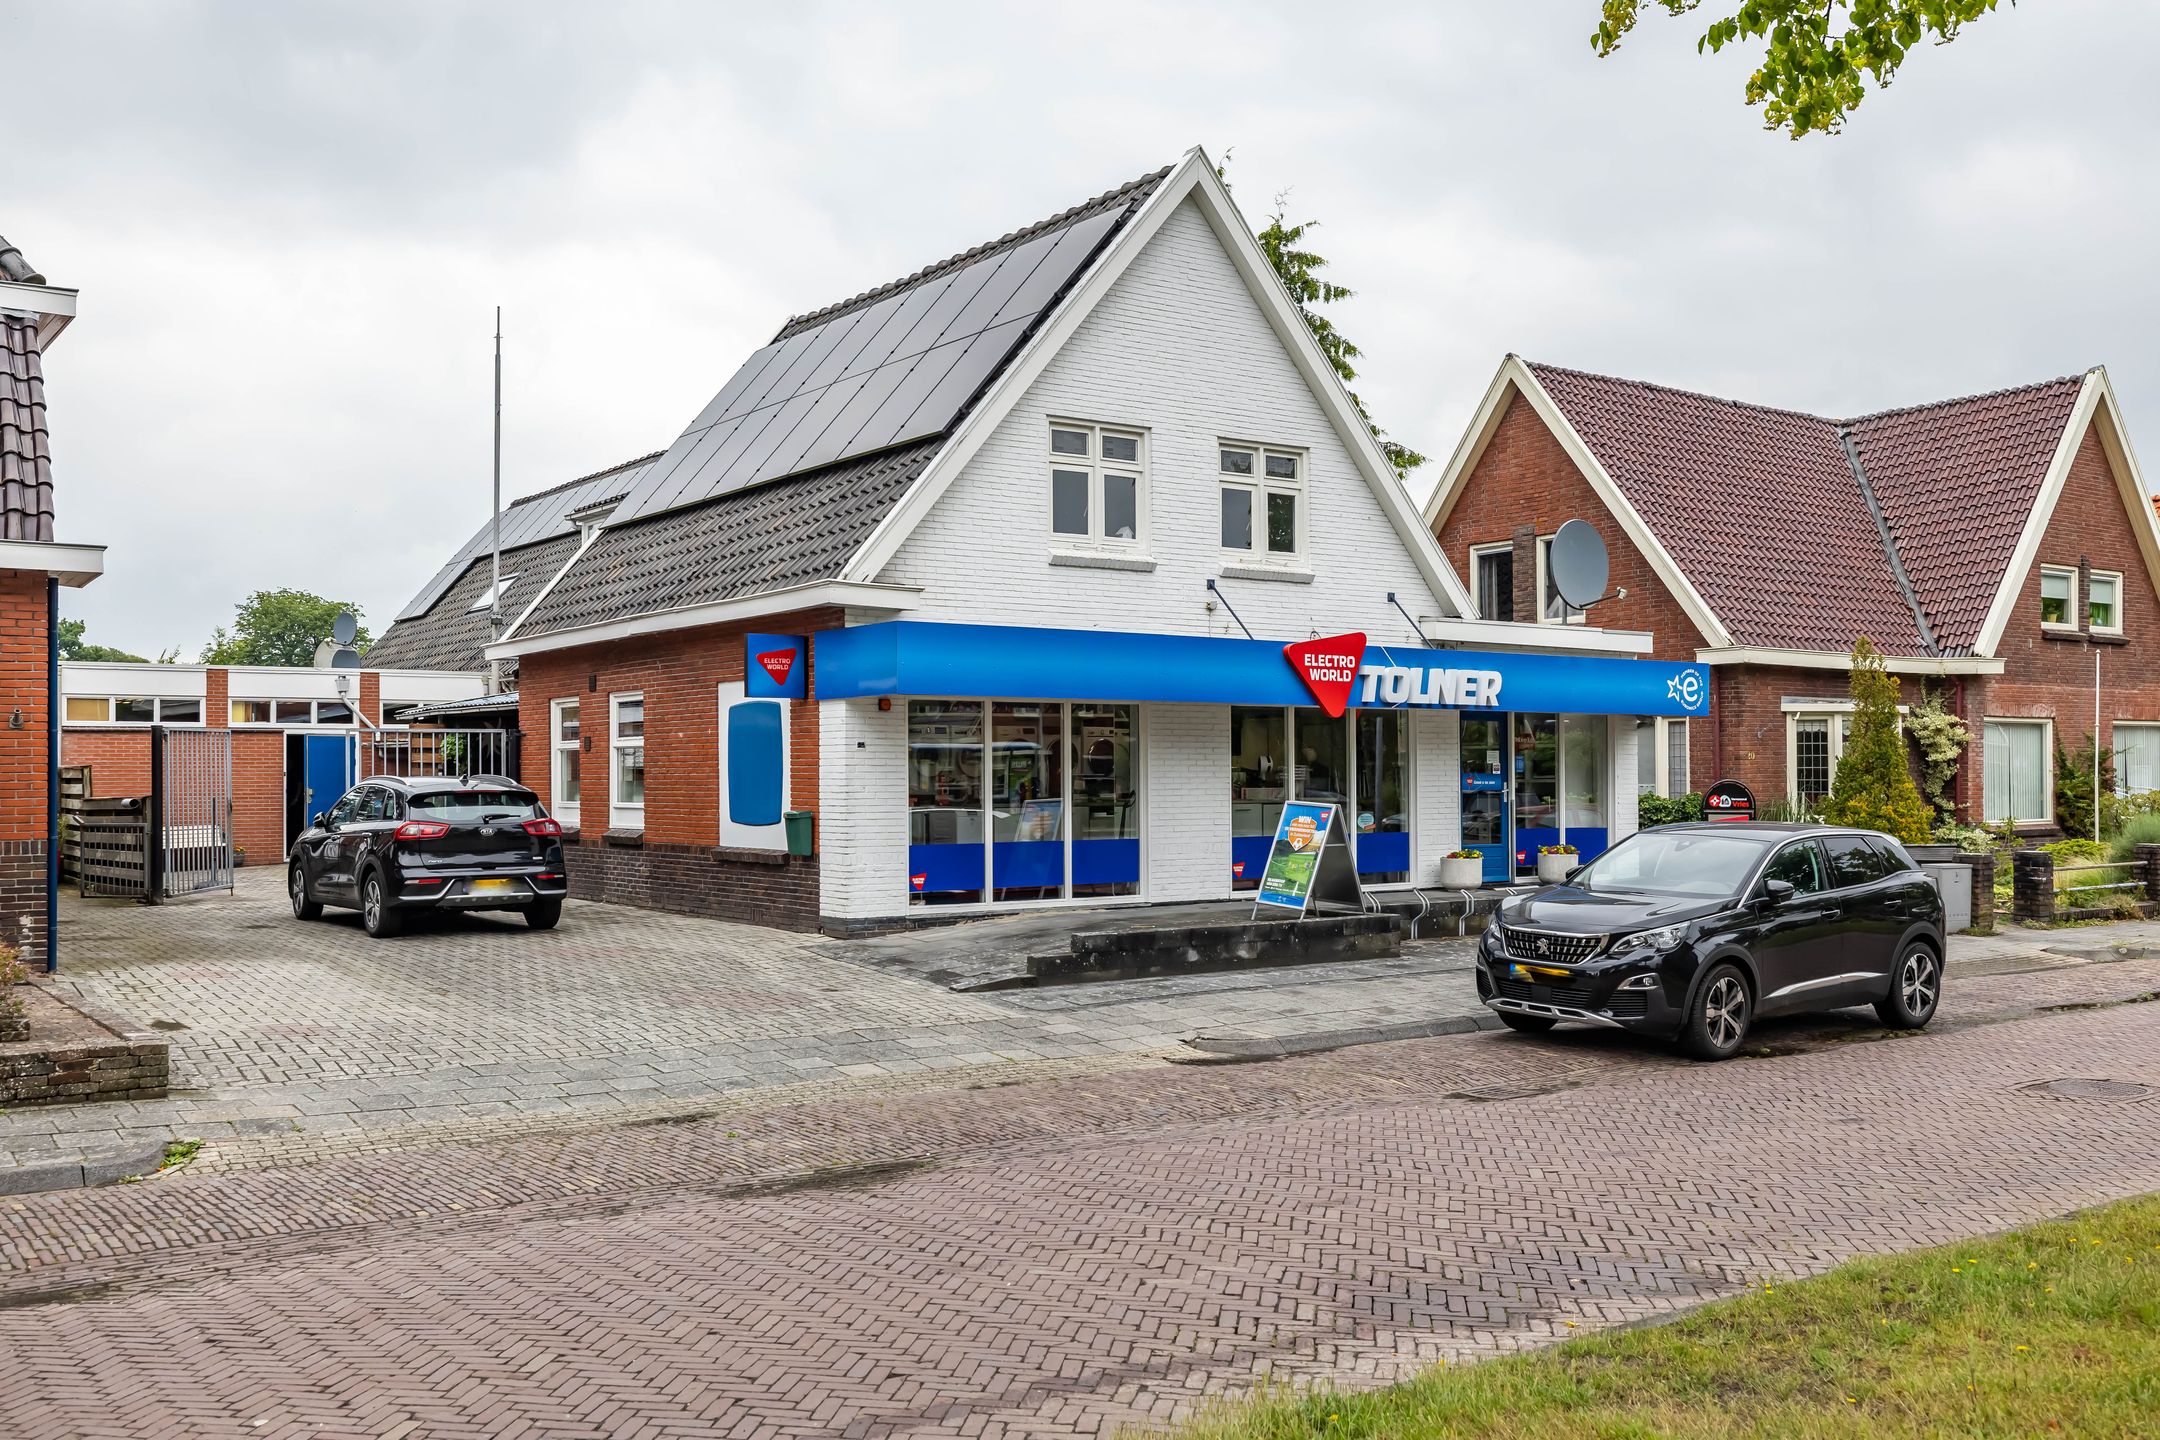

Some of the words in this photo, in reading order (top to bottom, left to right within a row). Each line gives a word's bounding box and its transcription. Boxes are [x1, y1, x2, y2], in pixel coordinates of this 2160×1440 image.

[1304, 653, 1355, 668] ELECTRO
[1309, 668, 1351, 682] WORLD
[1359, 665, 1502, 706] TOLNER
